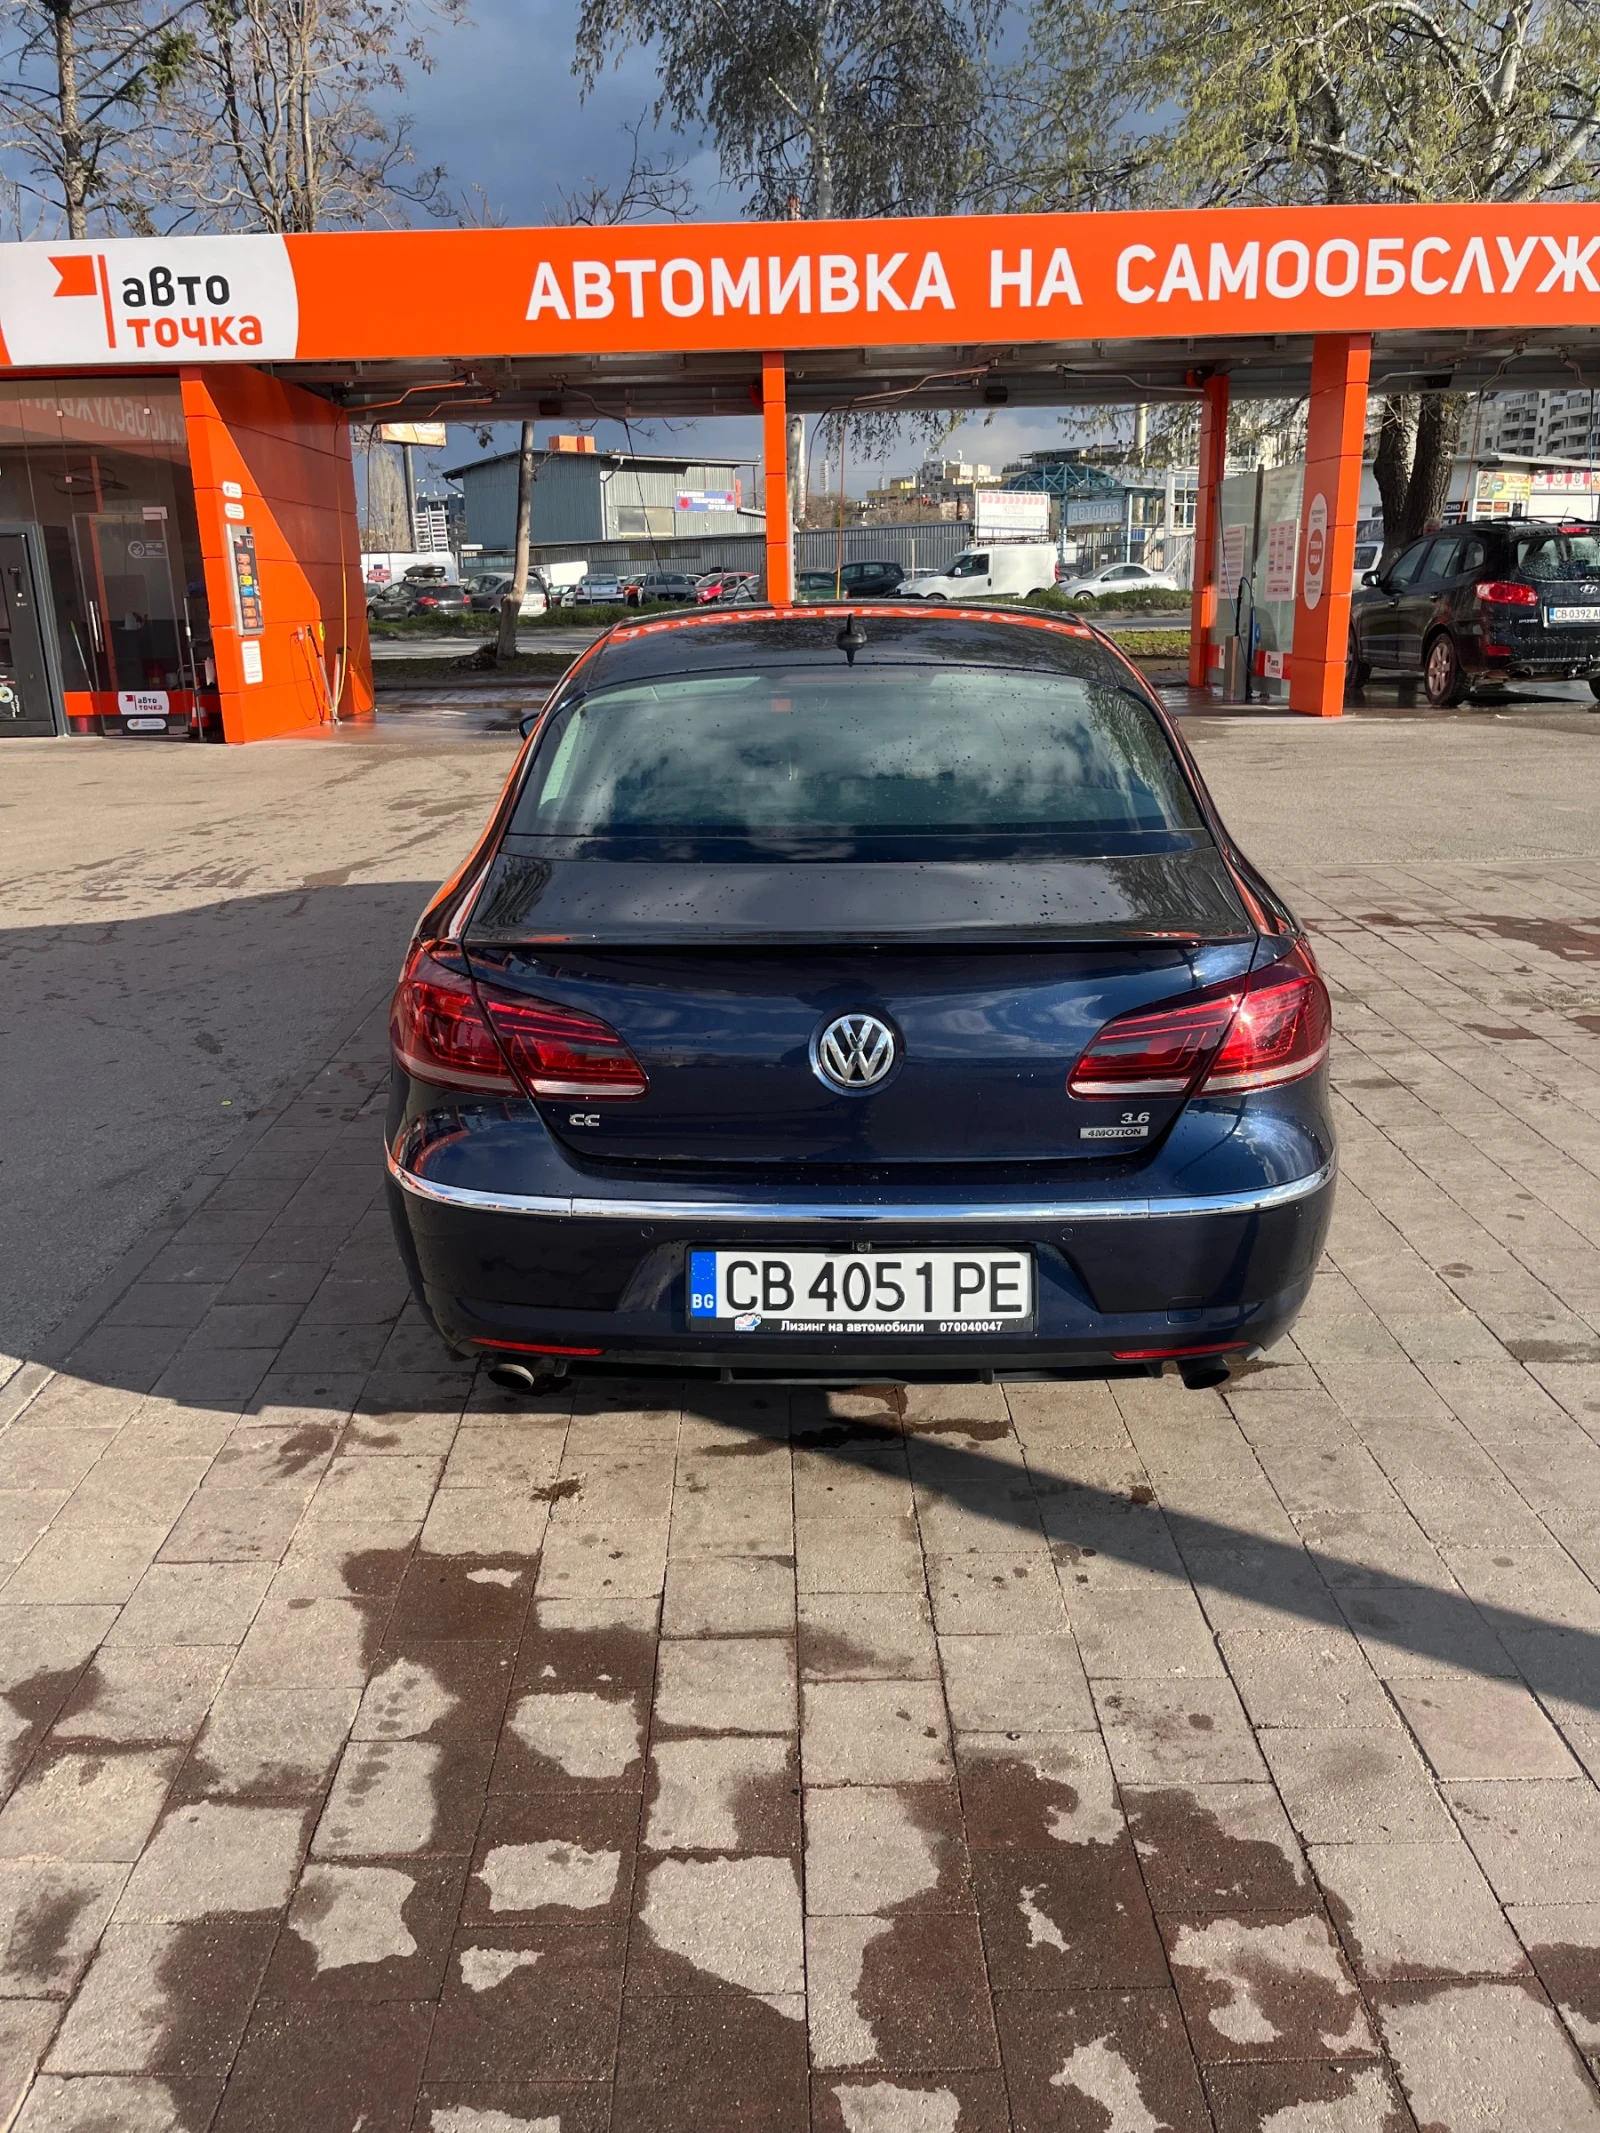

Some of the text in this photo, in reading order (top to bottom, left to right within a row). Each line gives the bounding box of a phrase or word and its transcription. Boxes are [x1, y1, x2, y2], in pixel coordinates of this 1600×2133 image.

[122, 265, 230, 308] авто
[525, 235, 1600, 322] АВТОМИВКА НА САМООБСЛУЖ
[126, 314, 264, 348] точка
[1071, 503, 1120, 522] АВТОГАЗ
[1569, 609, 1591, 618] 0392
[137, 696, 158, 704] авто
[568, 1113, 600, 1127] CC
[1087, 1128, 1142, 1137] 4MOTION
[807, 1261, 935, 1312] 4051
[953, 1261, 1024, 1313] PE
[692, 1293, 714, 1310] BG
[780, 1319, 1003, 1334] Лизинг на автомобили 070040047
